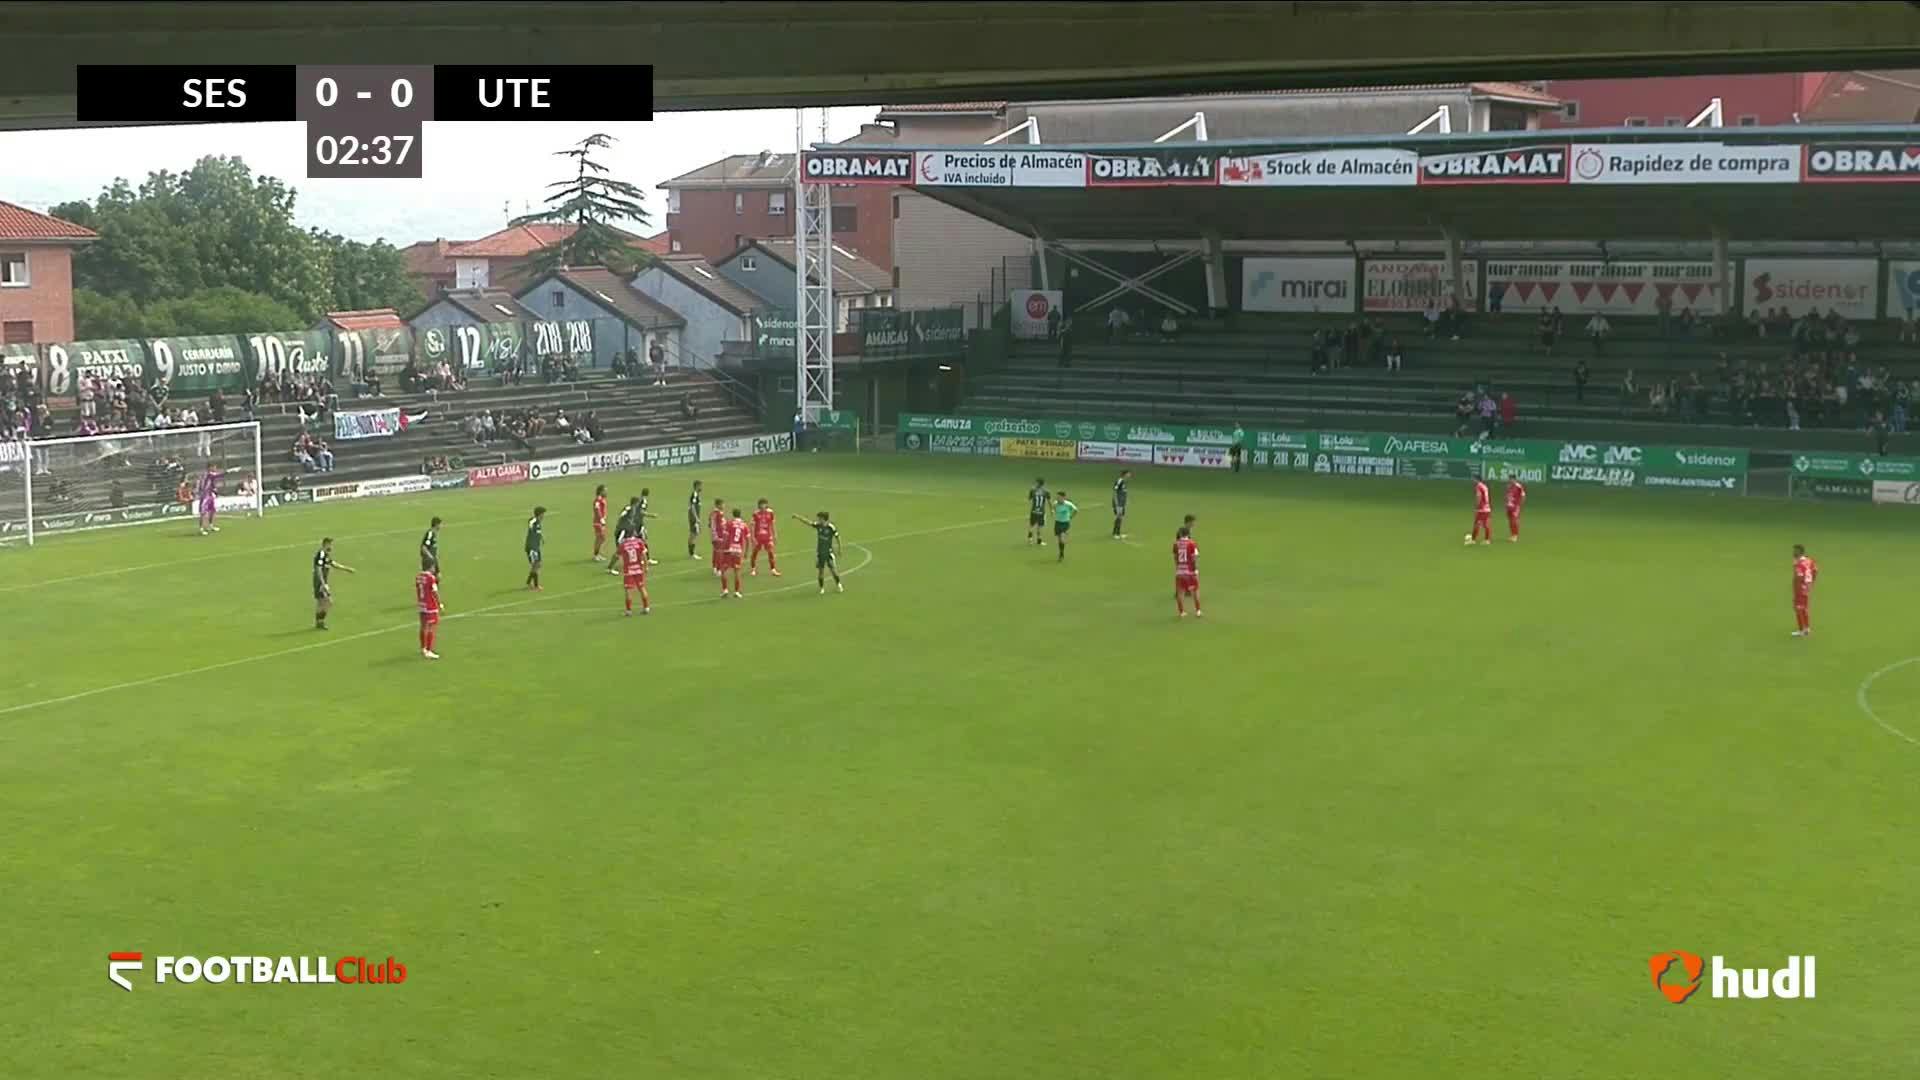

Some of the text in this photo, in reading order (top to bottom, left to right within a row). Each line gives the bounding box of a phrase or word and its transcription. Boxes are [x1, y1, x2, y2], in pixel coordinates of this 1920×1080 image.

[806, 157, 909, 177] OBRAMAT
[944, 153, 1083, 169] Precios de Almacén
[1266, 157, 1413, 175] Stock de Almacén
[1609, 154, 1791, 175] Rapidez de compra
[943, 171, 1006, 185] IVA incluido
[1367, 263, 1476, 274] ANDAMIS
[1280, 279, 1348, 299] mirai
[1775, 279, 1869, 300] sidenor
[457, 326, 485, 369] 12
[80, 349, 129, 365] PATXI
[153, 340, 175, 385] 9
[49, 344, 70, 395] 8
[177, 362, 207, 377] JUSTO
[1404, 440, 1449, 455] AFESA
[1687, 451, 1736, 466] sidenor
[476, 467, 497, 479] ALTA
[498, 464, 521, 477] GAMA
